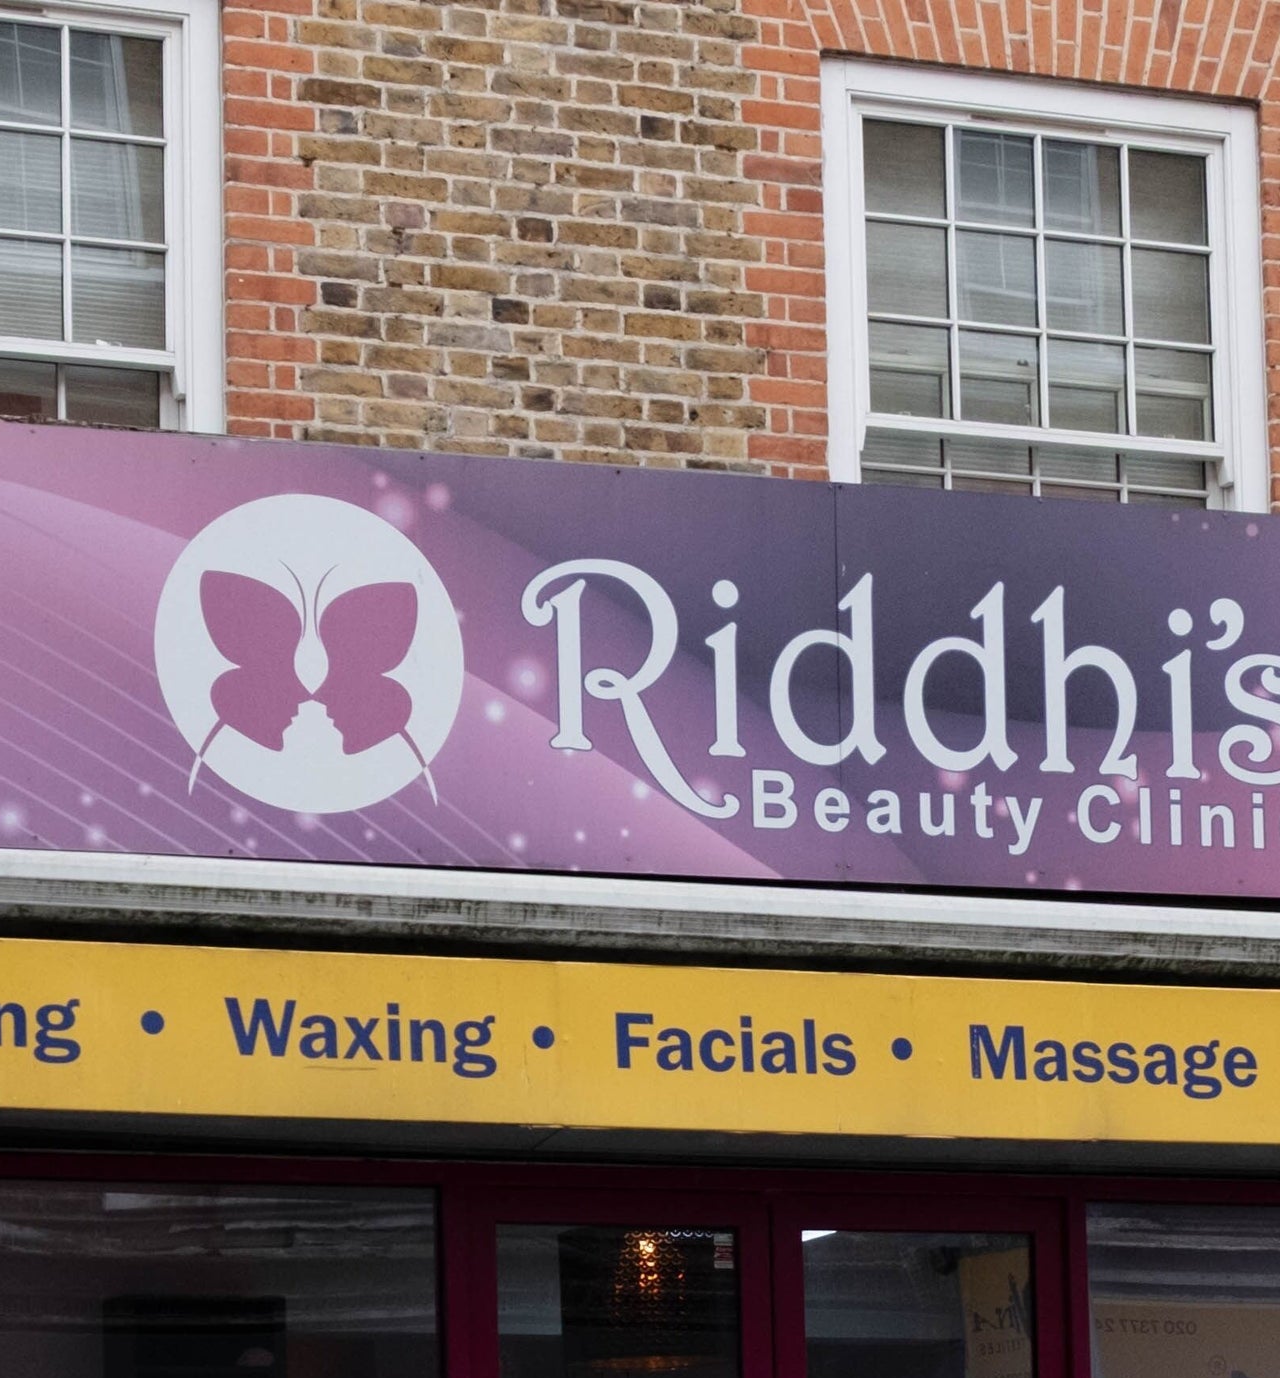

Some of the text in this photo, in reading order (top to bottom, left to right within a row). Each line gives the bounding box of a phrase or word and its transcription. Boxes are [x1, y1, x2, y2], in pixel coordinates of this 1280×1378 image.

[752, 769, 1043, 856] Beauty
[224, 995, 496, 1079] Waxing
[615, 1012, 858, 1078] Facials
[969, 1022, 1260, 1097] Massage
